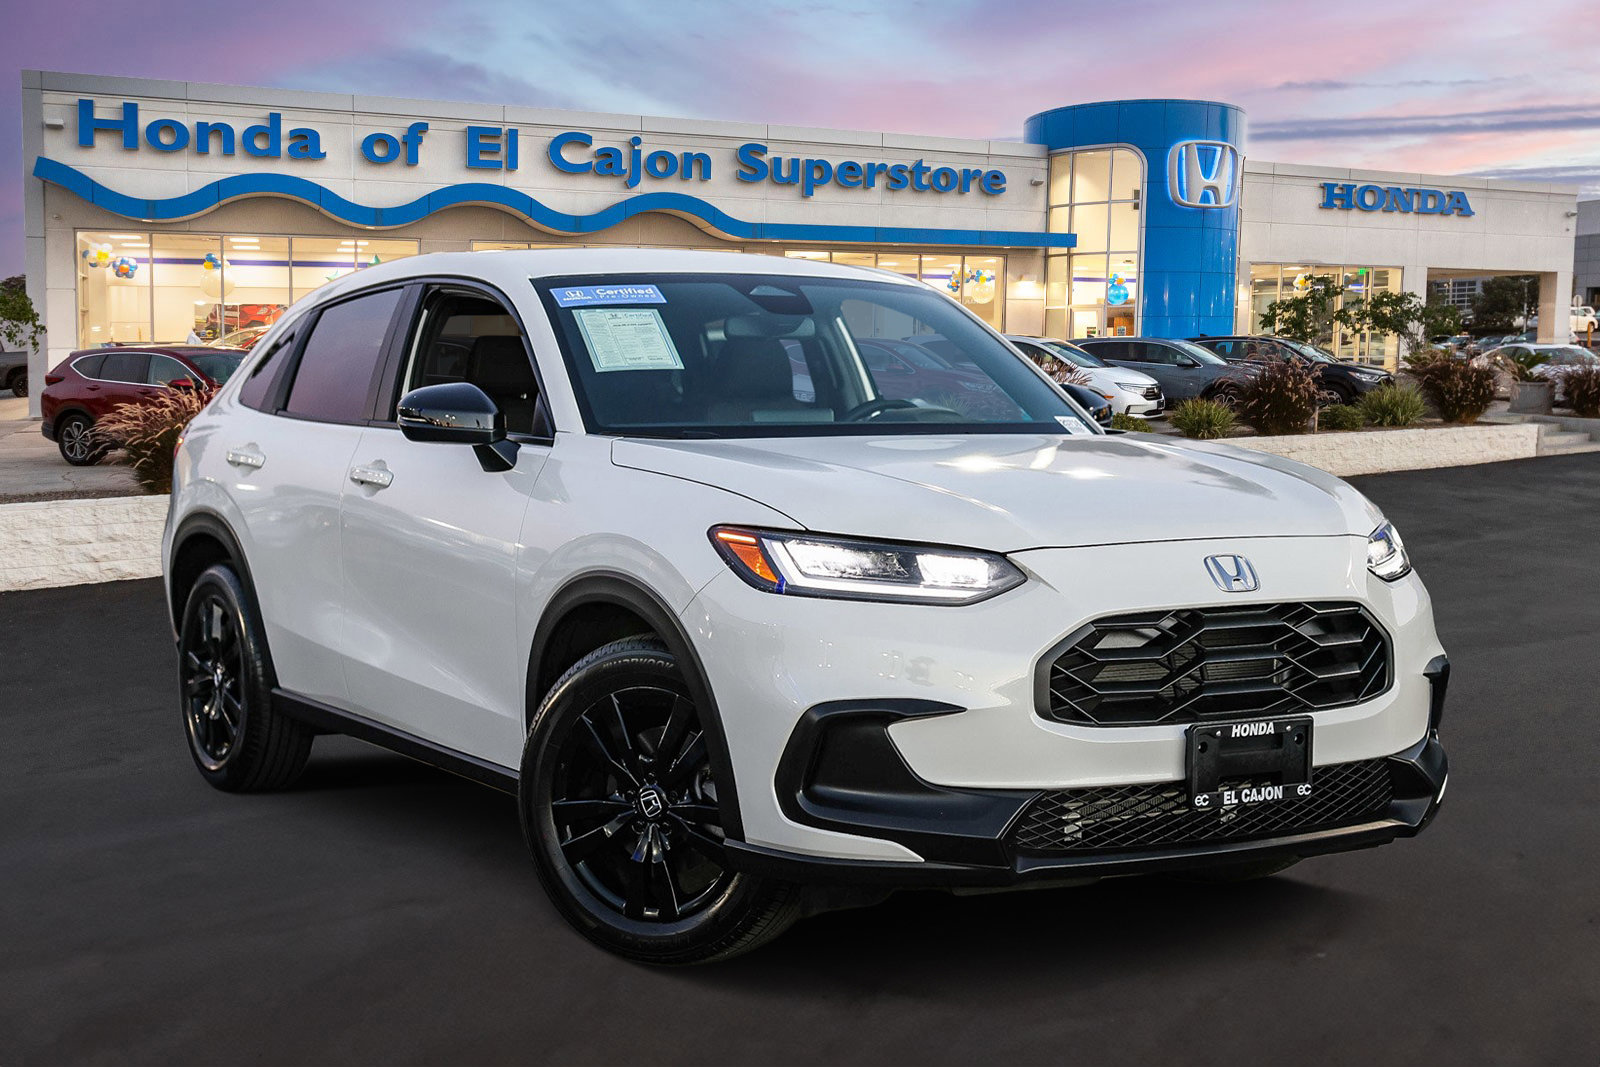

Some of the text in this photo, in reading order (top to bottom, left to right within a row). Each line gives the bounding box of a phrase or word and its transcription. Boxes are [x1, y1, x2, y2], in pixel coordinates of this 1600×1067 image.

[78, 98, 1007, 197] Honda of El Cajon Superstore
[1319, 181, 1475, 217] HONDA
[596, 287, 654, 295] Certified
[1231, 722, 1275, 738] HONDA
[1223, 790, 1239, 805] EL
[1241, 785, 1283, 800] CAJON
